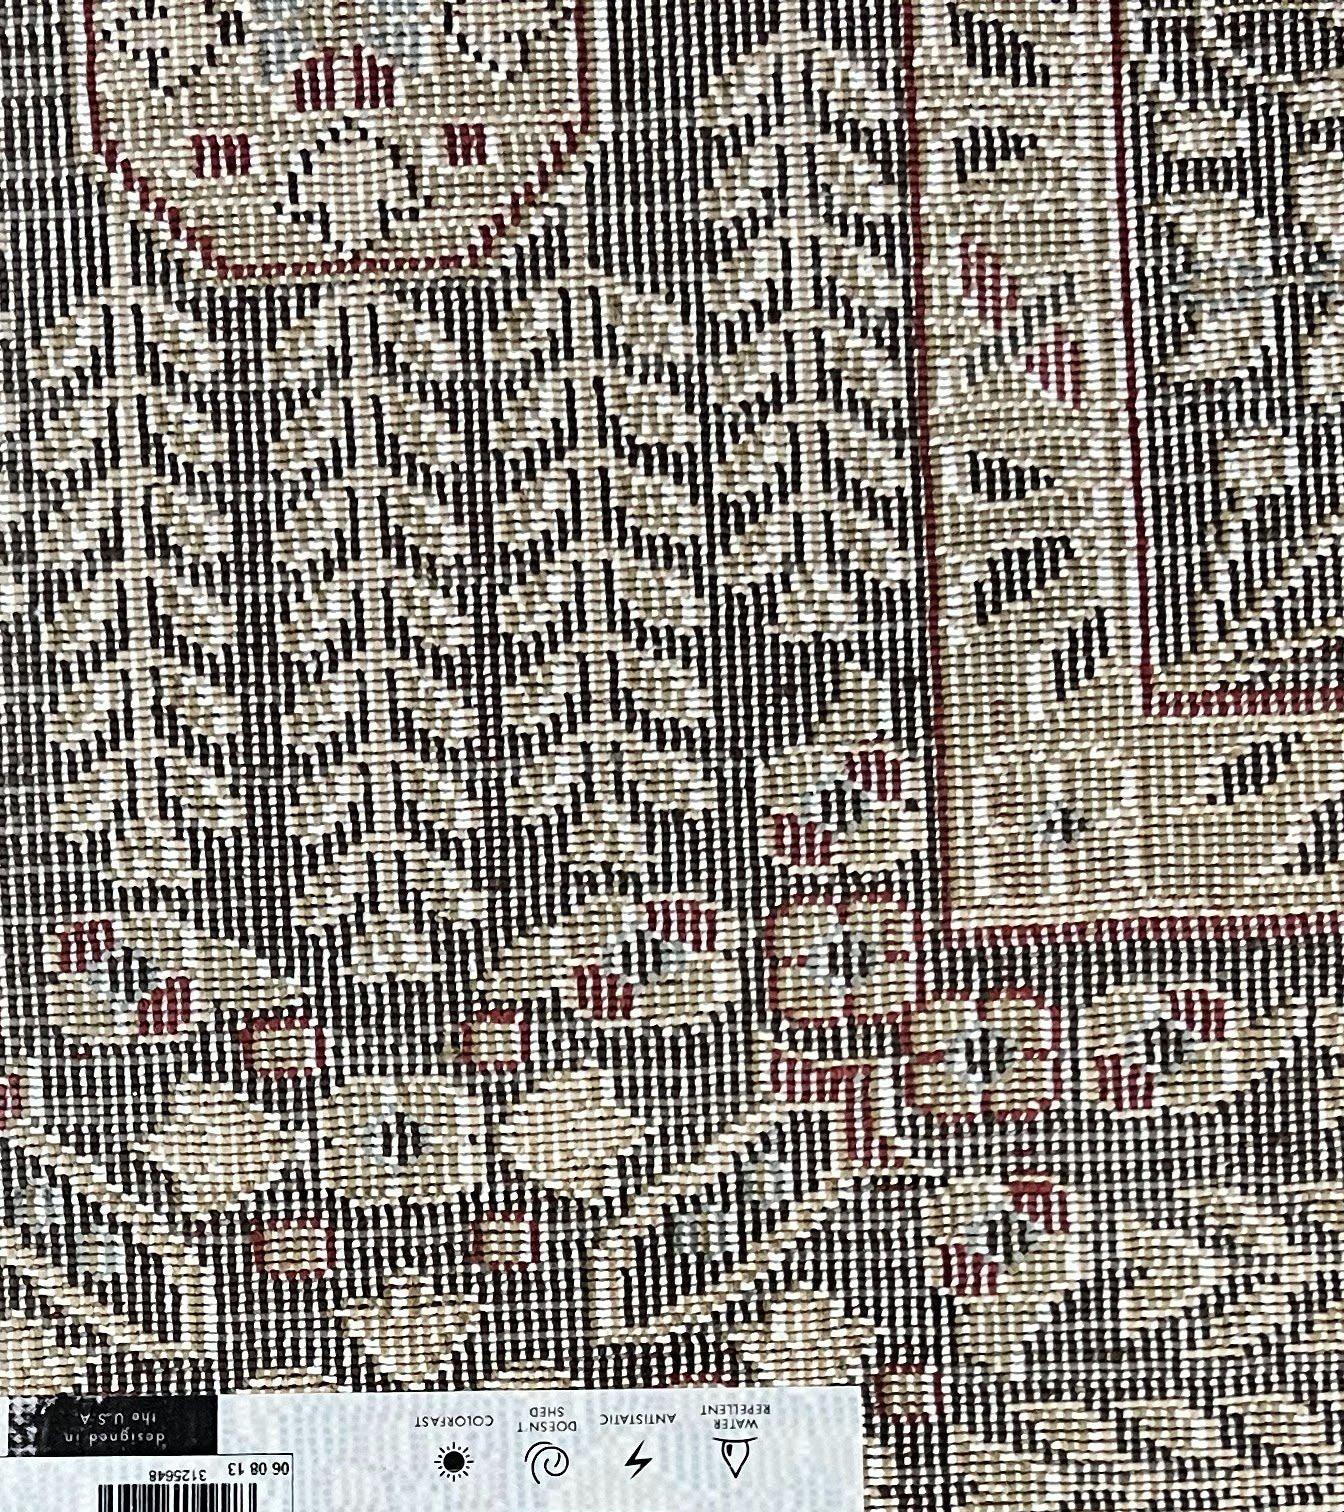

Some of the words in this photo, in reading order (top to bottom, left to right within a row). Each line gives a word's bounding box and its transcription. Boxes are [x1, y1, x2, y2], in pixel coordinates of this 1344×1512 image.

[528, 1406, 564, 1418] SHED
[700, 1402, 770, 1415] REPELLENT
[131, 1412, 155, 1425] the
[414, 1414, 493, 1427] COLORFAST
[598, 1412, 676, 1425] ANTISTATIC
[712, 1417, 758, 1429] WATER
[516, 1420, 576, 1432] DOESN'T
[63, 1432, 79, 1446] in
[88, 1426, 164, 1446] designed
[226, 1462, 244, 1476] 13
[249, 1462, 266, 1475] 08
[271, 1460, 289, 1474] 06
[148, 1468, 206, 1481] 3125648
